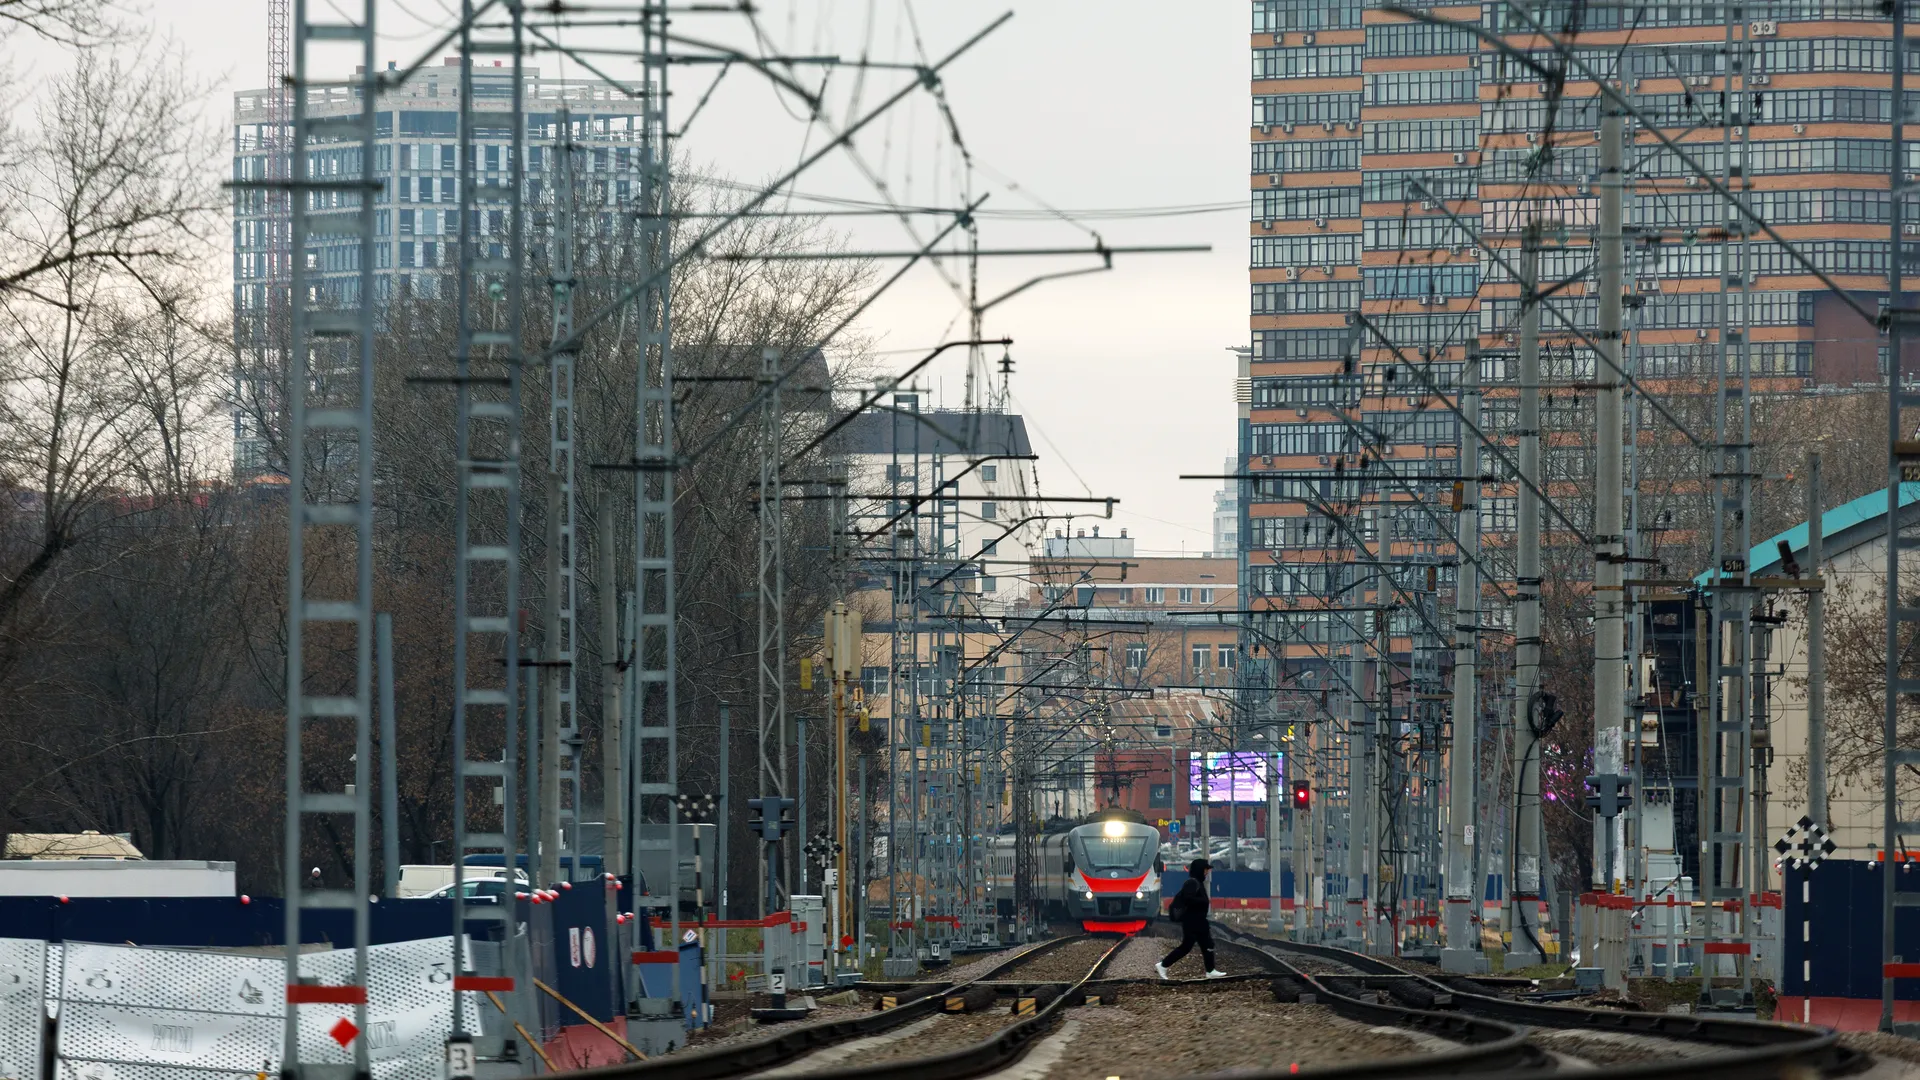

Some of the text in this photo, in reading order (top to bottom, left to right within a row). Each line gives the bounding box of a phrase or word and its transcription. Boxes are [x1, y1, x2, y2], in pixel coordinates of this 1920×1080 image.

[856, 702, 862, 711] 4
[774, 976, 782, 989] 2
[453, 1048, 468, 1070] 3
